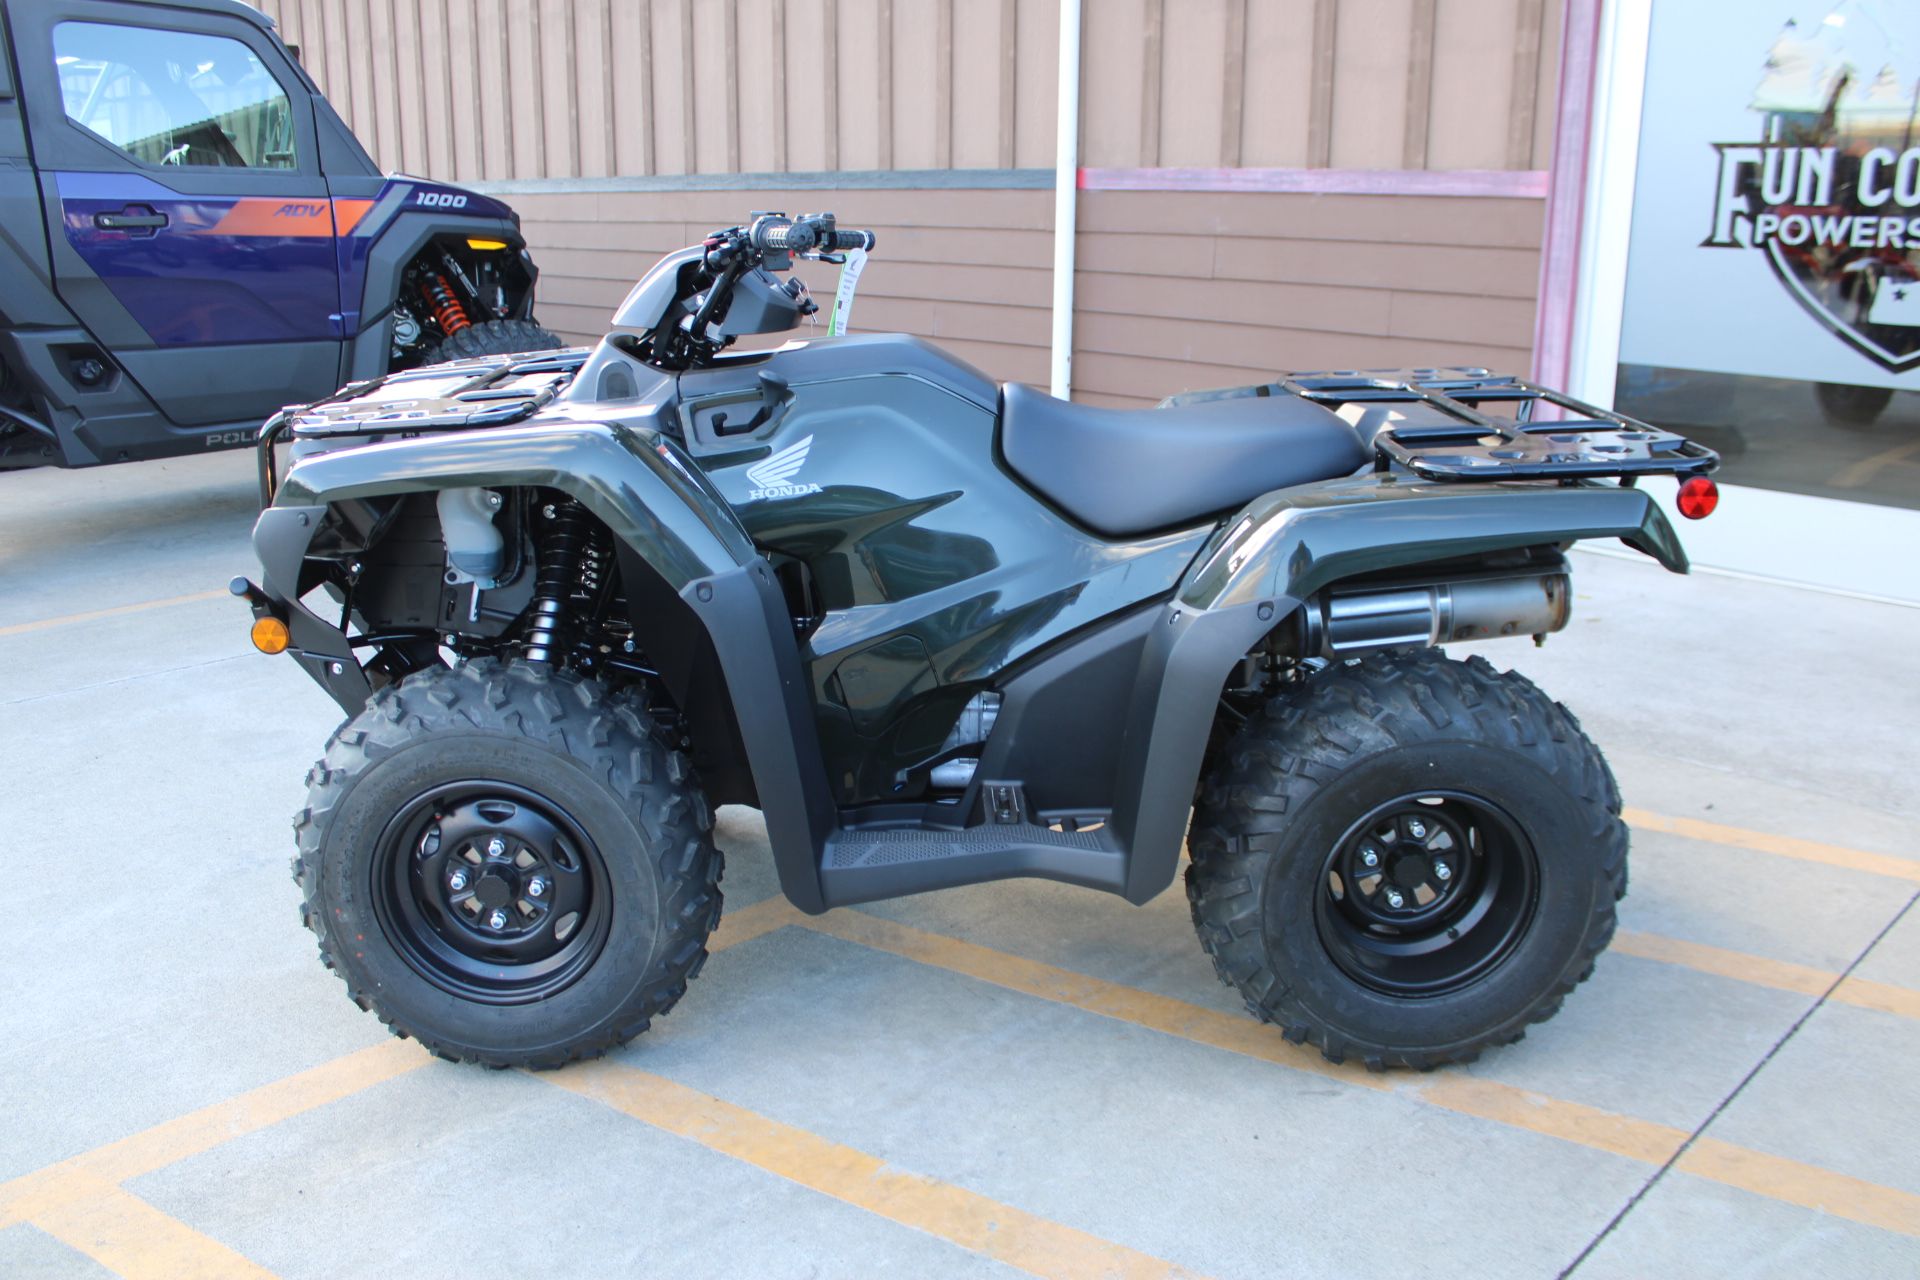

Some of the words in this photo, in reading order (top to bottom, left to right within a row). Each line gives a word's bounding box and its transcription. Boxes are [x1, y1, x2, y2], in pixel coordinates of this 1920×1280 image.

[416, 191, 468, 208] 1000
[1700, 143, 1837, 247] FUN
[1857, 147, 1920, 208] CO
[274, 204, 325, 217] ADV
[749, 482, 823, 500] HONDA
